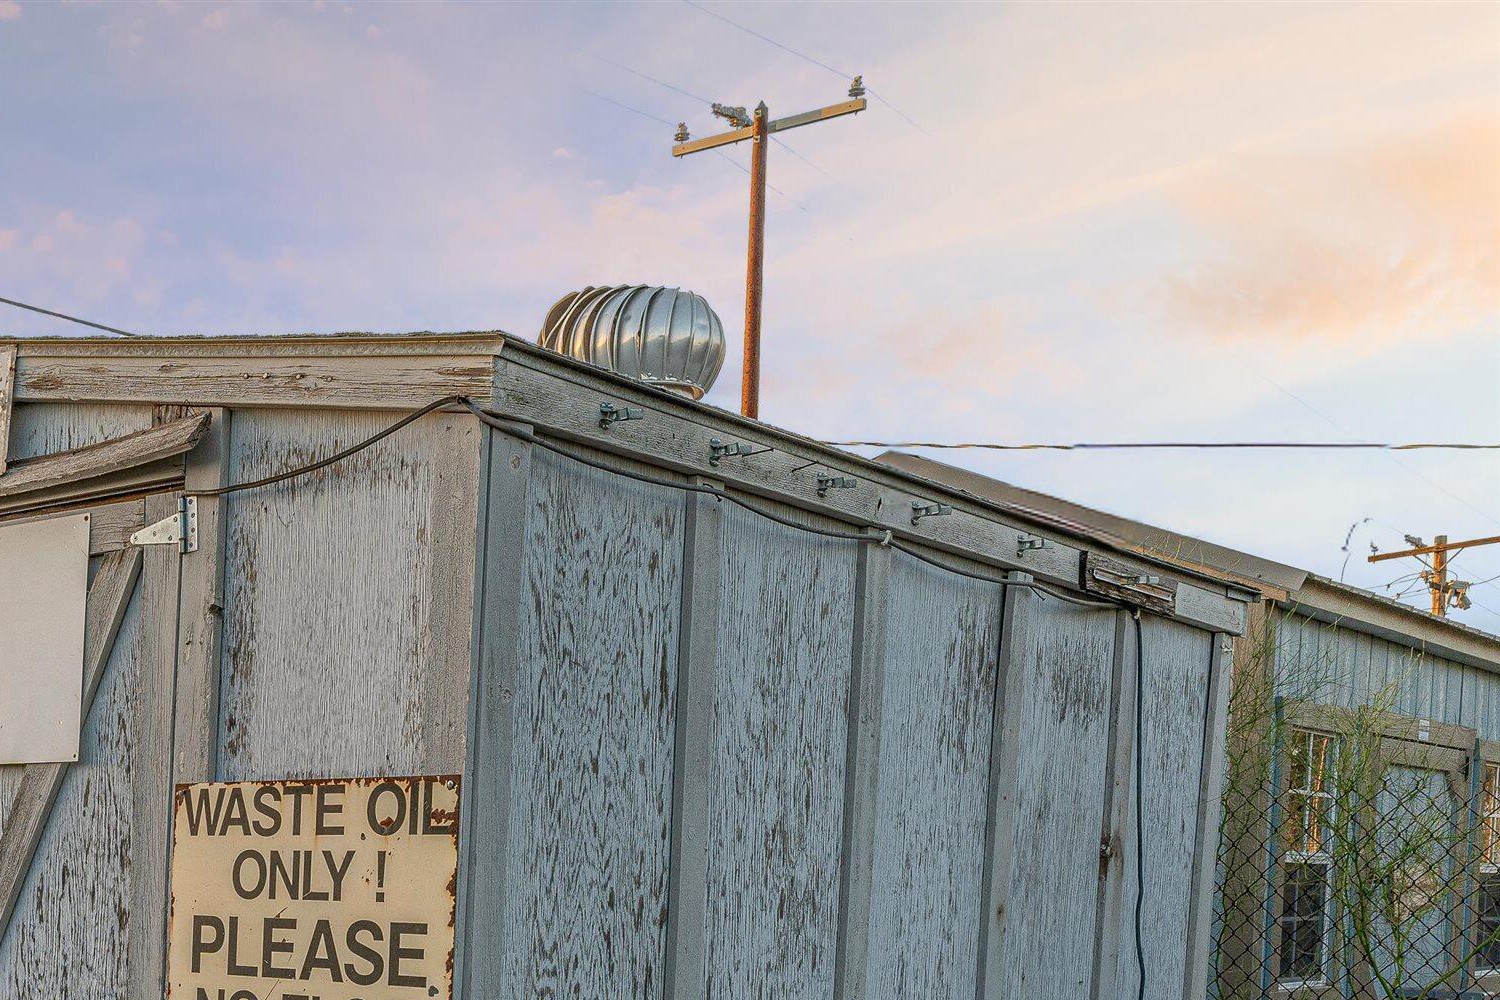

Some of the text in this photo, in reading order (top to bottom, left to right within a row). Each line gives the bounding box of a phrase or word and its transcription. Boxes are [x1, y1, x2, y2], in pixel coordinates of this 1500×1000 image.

[184, 780, 452, 837] WASTE OIL
[232, 849, 356, 902] ONLY
[191, 914, 428, 988] PLEASE
